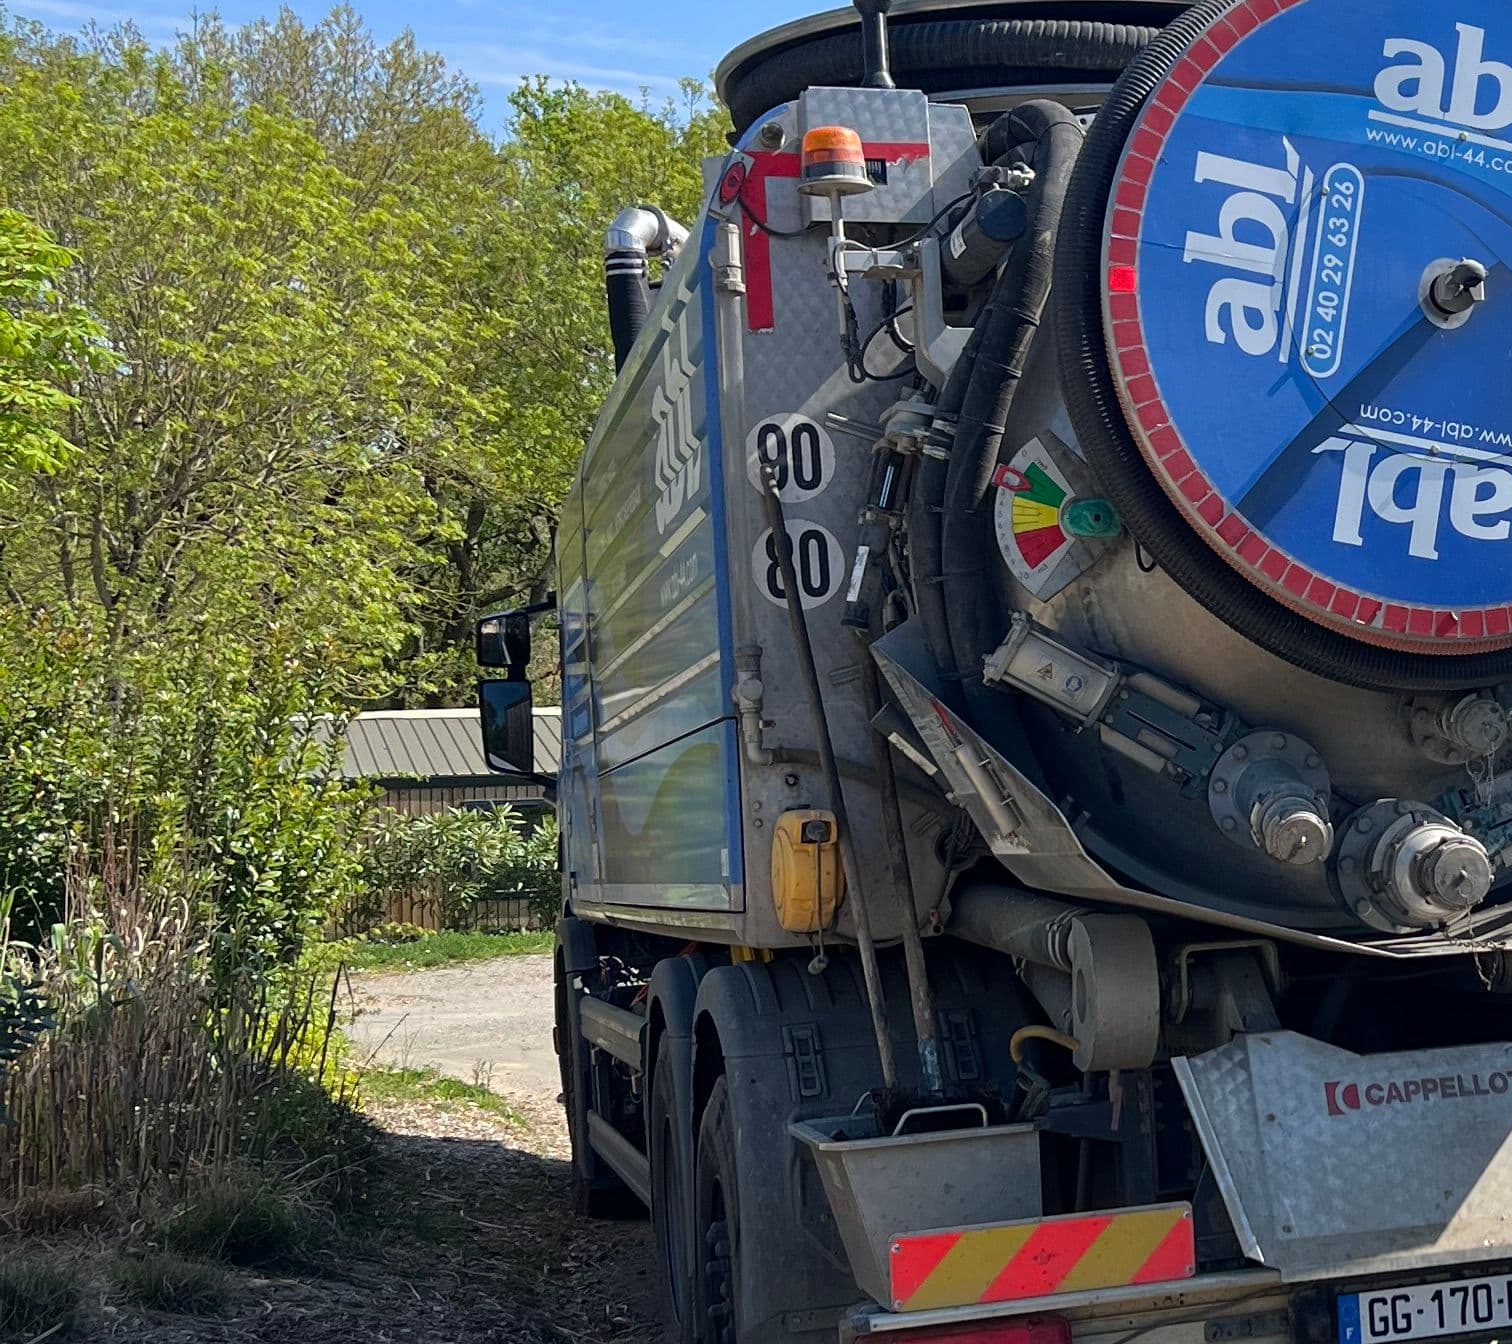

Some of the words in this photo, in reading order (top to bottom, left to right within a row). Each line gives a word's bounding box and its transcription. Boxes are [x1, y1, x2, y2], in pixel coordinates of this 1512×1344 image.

[1332, 181, 1355, 211] 26
[1183, 136, 1301, 356] abl
[1327, 217, 1350, 247] 63
[1321, 254, 1344, 286] 29
[1316, 291, 1340, 322] 40
[1311, 328, 1334, 359] 02
[757, 423, 822, 490] 90
[766, 529, 830, 599] 80
[1346, 1327, 1354, 1340] F
